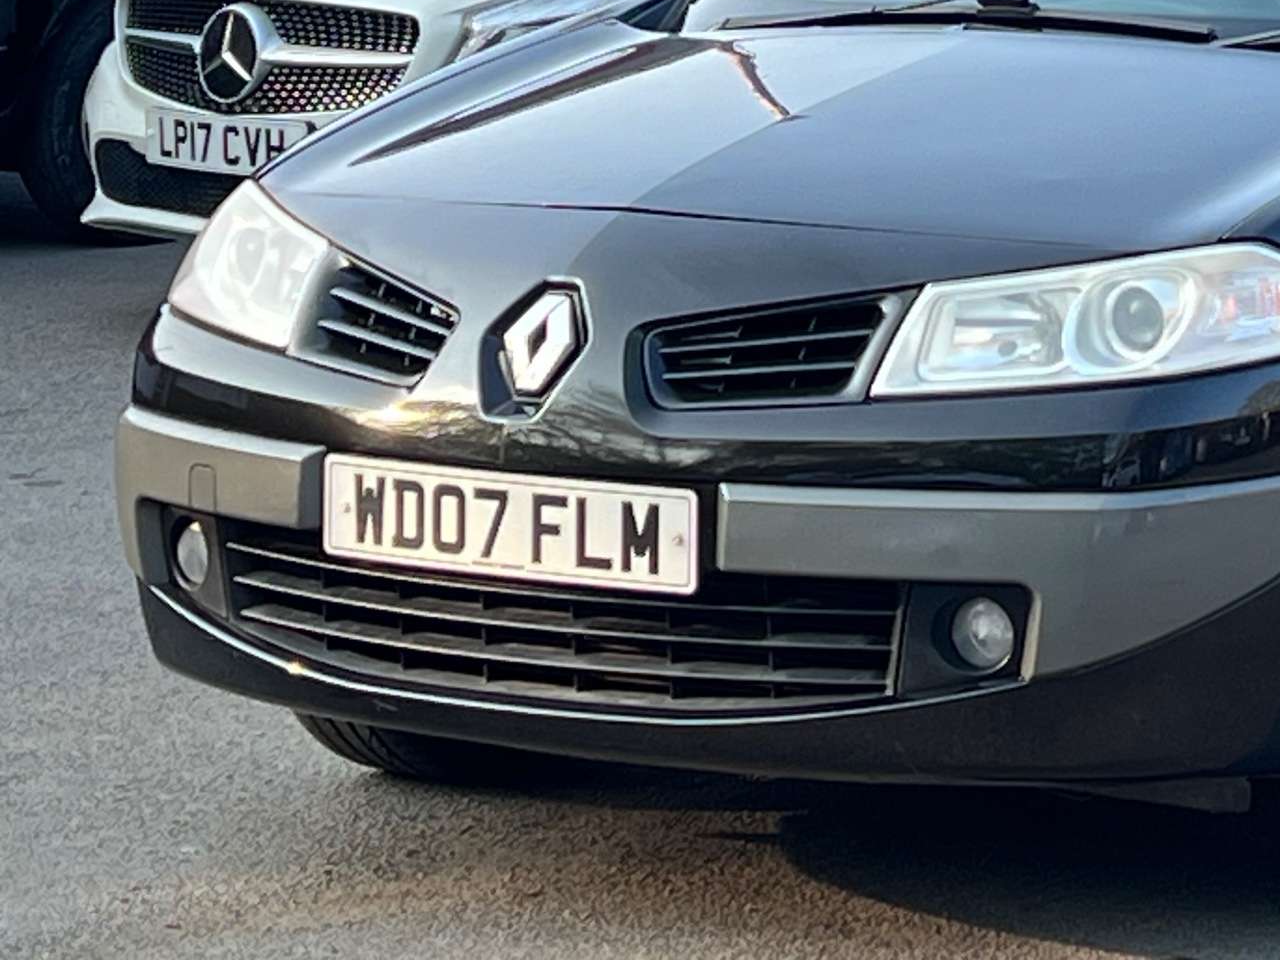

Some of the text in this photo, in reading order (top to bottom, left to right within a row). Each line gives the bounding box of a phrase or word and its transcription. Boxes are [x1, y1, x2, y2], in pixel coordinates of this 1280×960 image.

[158, 116, 286, 166] LP17 CVH
[354, 473, 659, 575] WD07 FLM
